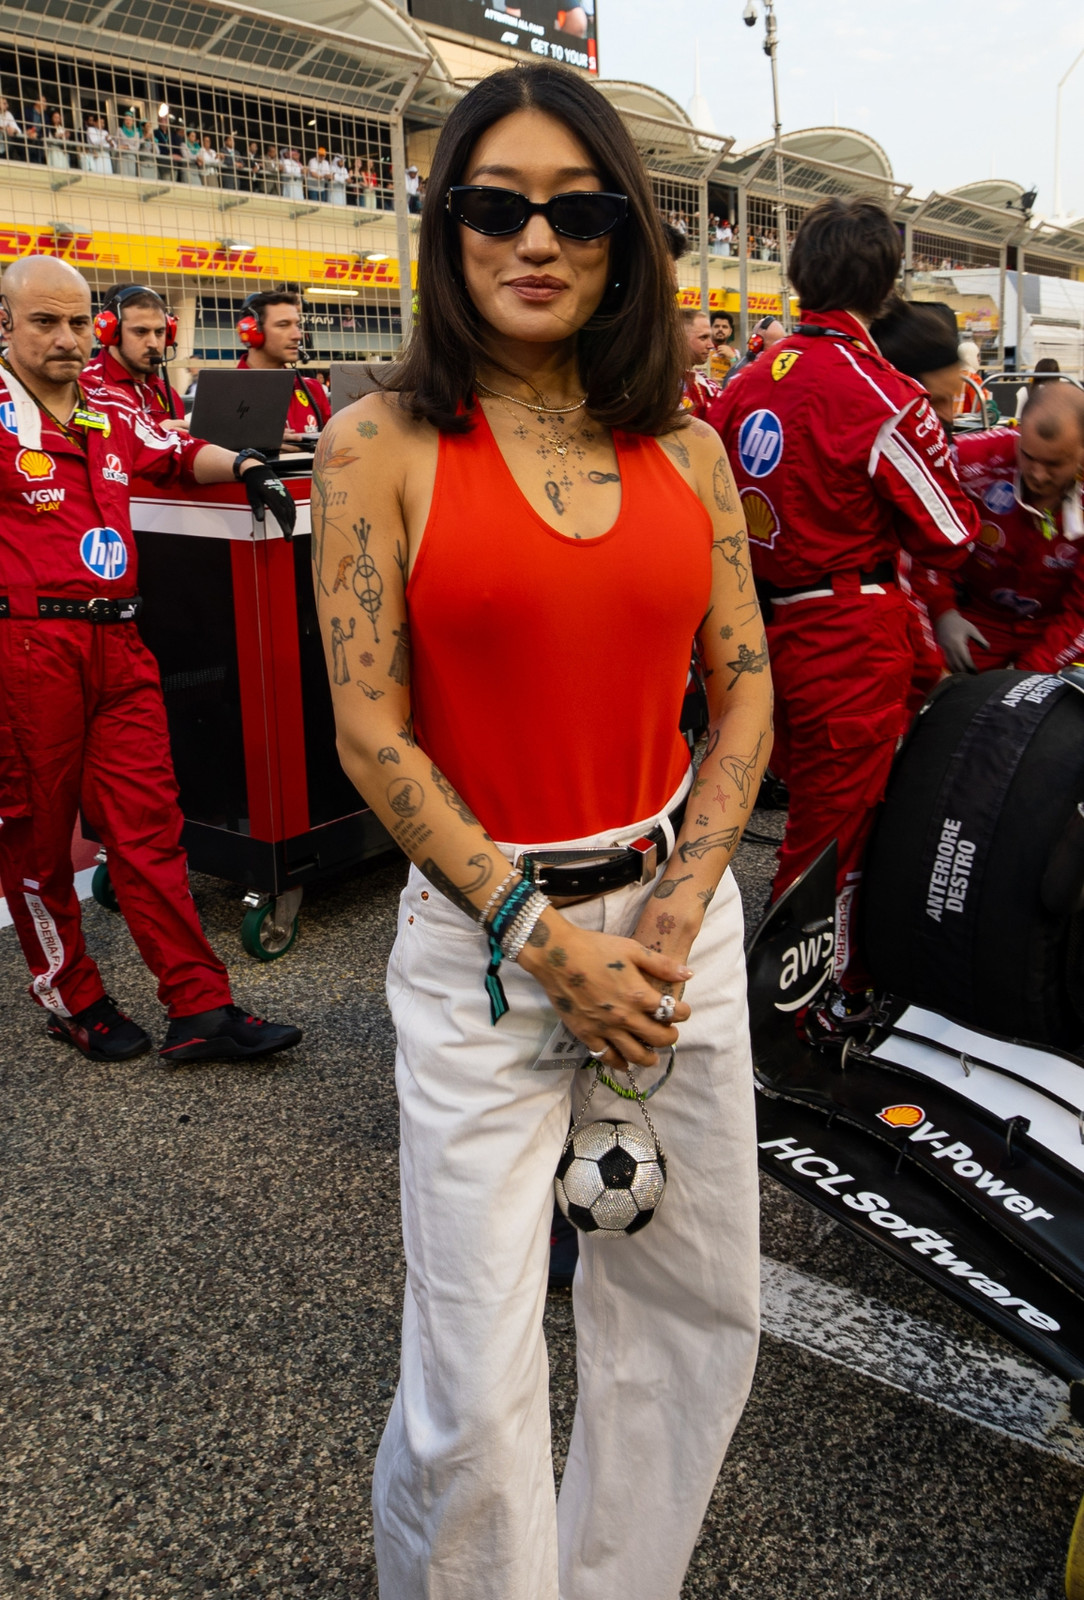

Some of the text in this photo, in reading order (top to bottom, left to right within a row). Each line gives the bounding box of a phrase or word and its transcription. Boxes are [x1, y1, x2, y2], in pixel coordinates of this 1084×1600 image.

[530, 37, 550, 56] GET
[550, 43, 564, 61] TO
[564, 47, 588, 68] YOUR
[0, 230, 100, 260] DHL
[177, 245, 263, 273] DHL
[324, 258, 394, 283] DHL
[747, 296, 778, 311] DHL
[742, 411, 780, 475] hp
[21, 488, 65, 504] VGW
[35, 501, 60, 512] PLAY
[89, 529, 123, 578] hp
[926, 817, 962, 923] ANTERIORE
[945, 840, 976, 913] DESTRO
[30, 901, 59, 954] SCUDERIA
[780, 931, 834, 991] aws
[44, 990, 59, 1008] HP
[908, 1121, 1055, 1222] V-Power
